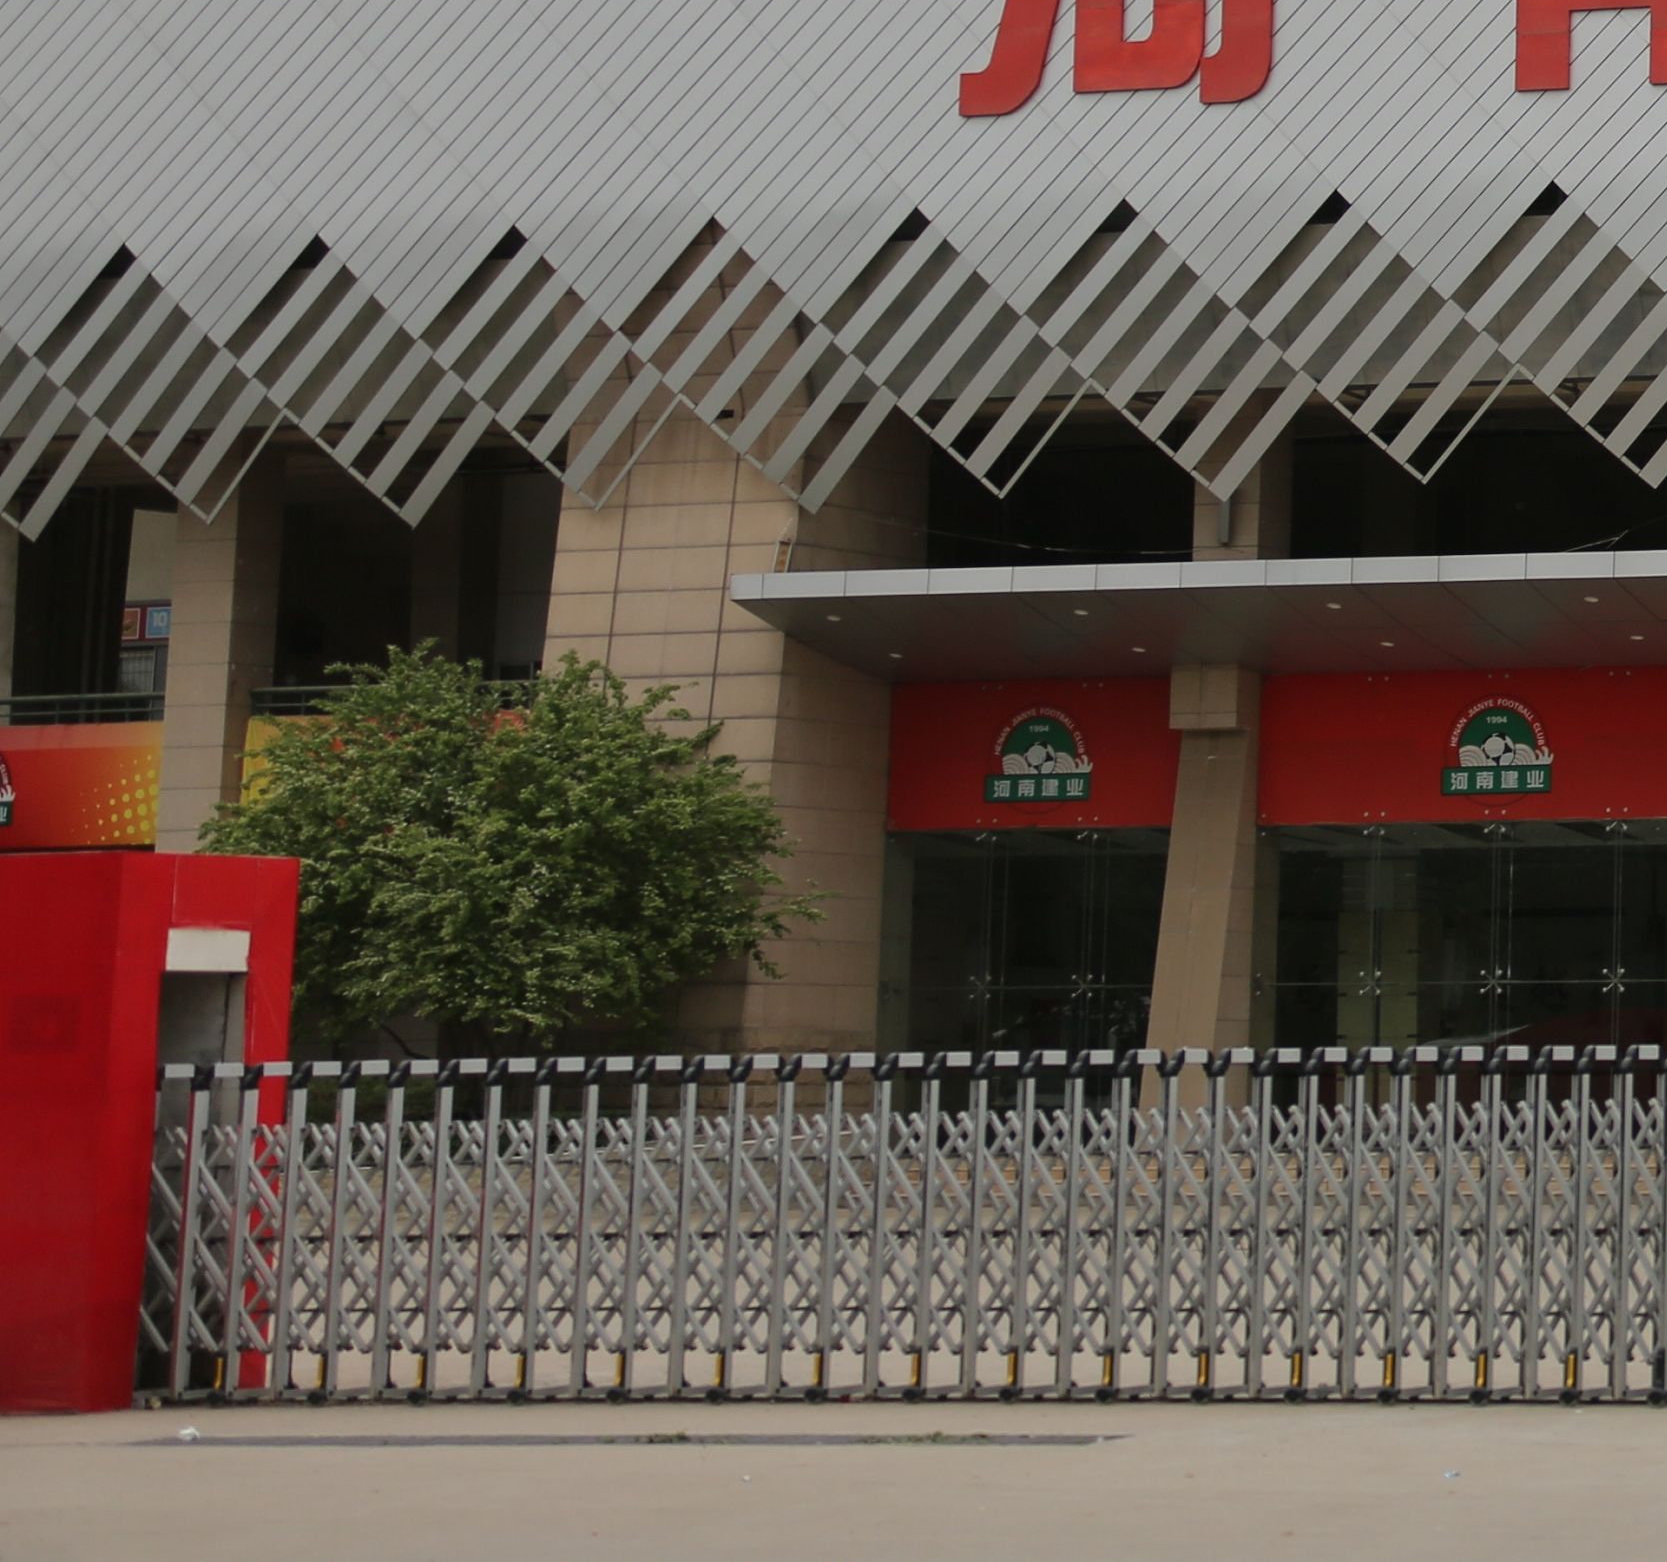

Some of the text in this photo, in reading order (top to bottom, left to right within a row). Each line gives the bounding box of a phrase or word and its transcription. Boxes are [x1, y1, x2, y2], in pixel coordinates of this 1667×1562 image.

[1497, 698, 1536, 722] FOOTBALL
[1533, 722, 1545, 746] CLUB
[993, 778, 1084, 798] 河南建业
[1450, 770, 1544, 790] 河南建业
